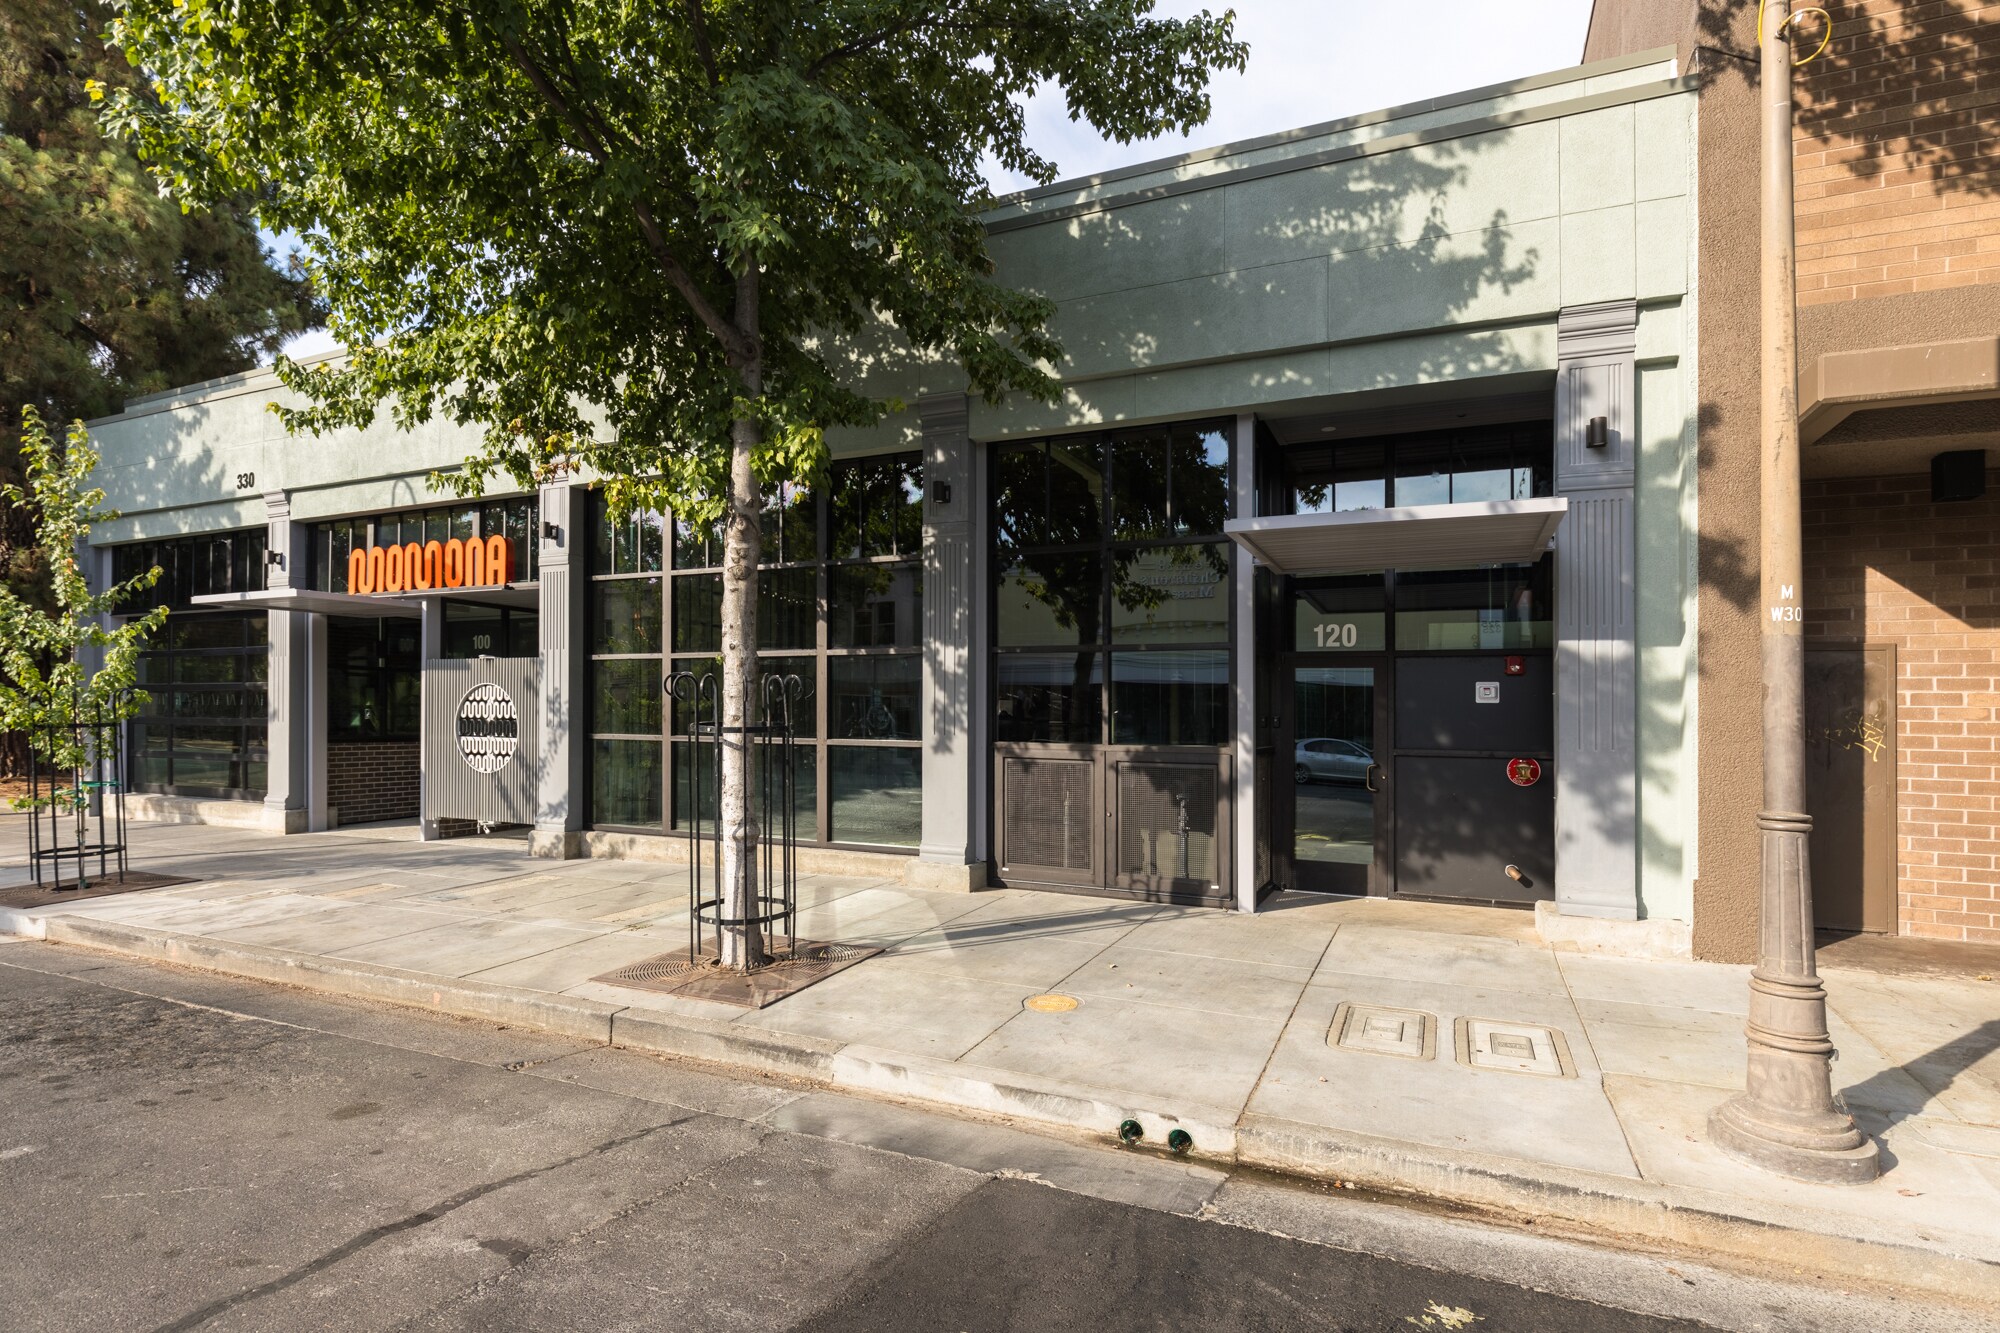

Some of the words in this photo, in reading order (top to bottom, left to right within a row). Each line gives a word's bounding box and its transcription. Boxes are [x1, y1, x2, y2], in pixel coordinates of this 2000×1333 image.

[237, 472, 255, 489] 330
[348, 535, 508, 595] MOMONA
[1781, 584, 1793, 600] M
[1770, 606, 1802, 622] W30
[473, 635, 491, 649] 100
[1313, 623, 1357, 648] 120
